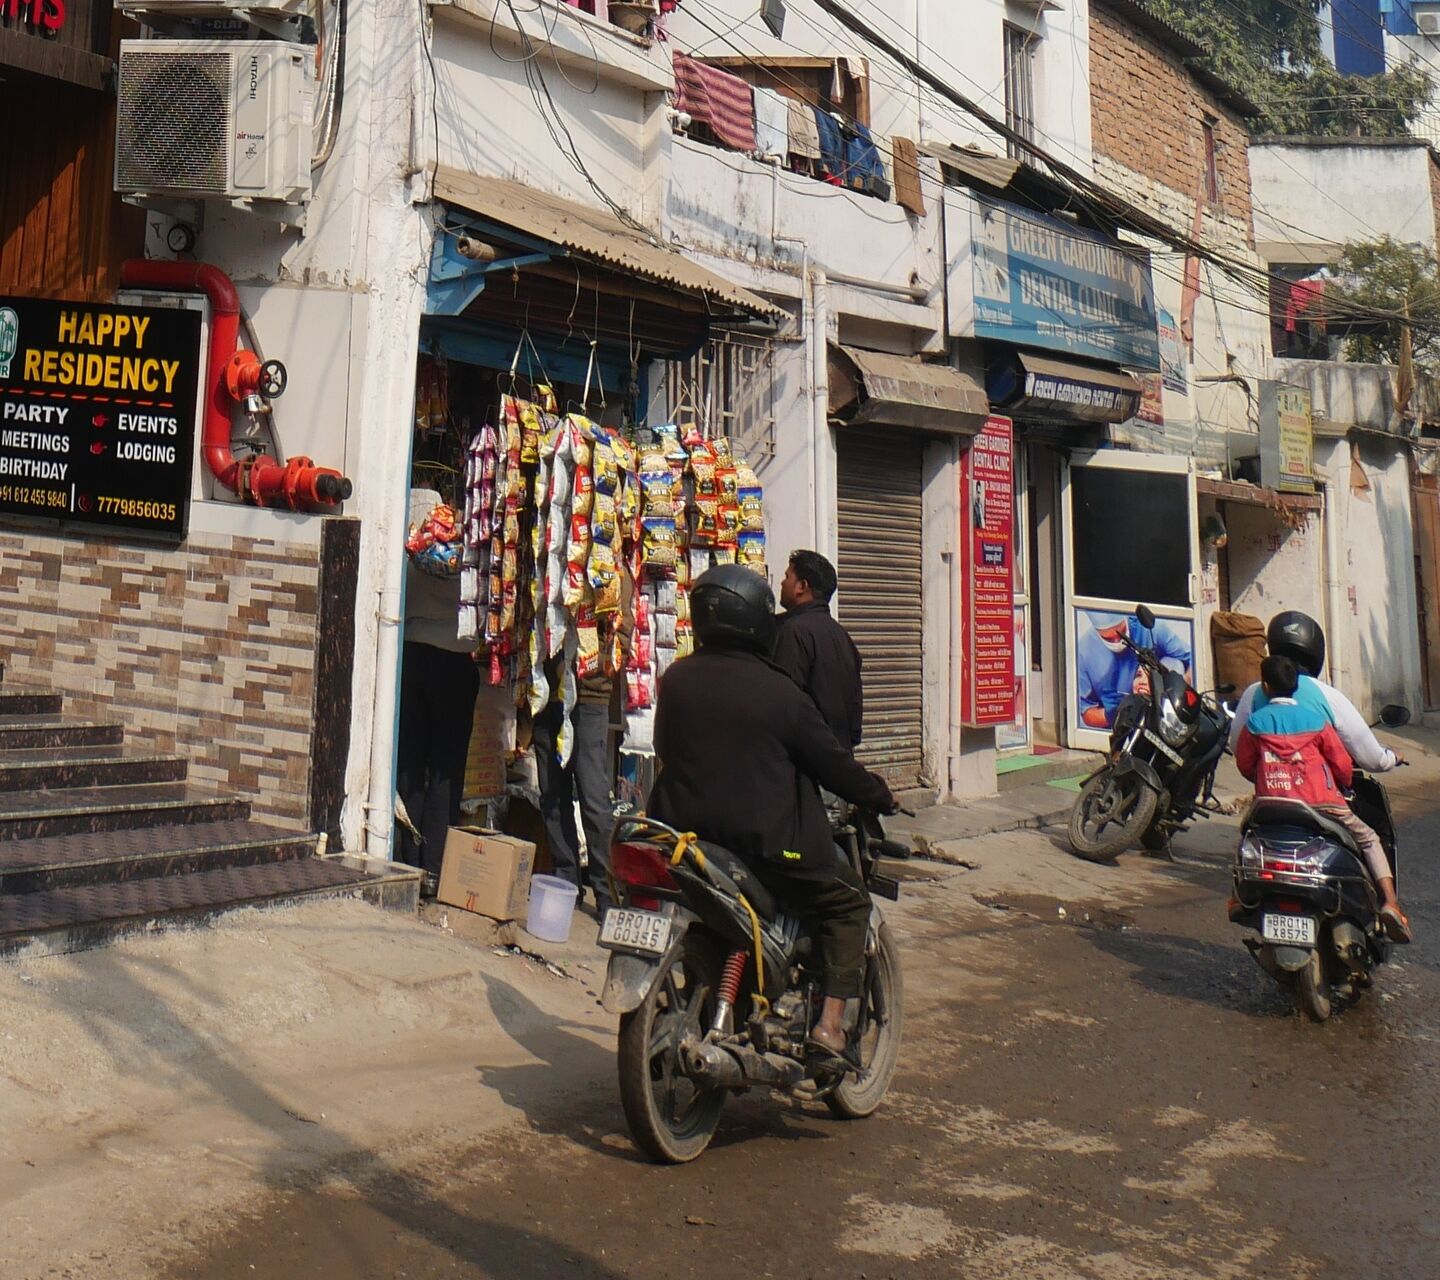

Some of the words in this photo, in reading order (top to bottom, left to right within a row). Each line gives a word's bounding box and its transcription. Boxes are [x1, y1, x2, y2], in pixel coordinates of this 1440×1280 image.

[249, 56, 258, 100] HITACHI
[236, 131, 247, 140] air
[1009, 216, 1057, 263] GREEN
[1020, 268, 1077, 315] DENTAL
[1077, 284, 1121, 326] CLINIC
[58, 310, 150, 350] HAPPY
[23, 349, 180, 394] RESIDENCY
[3, 402, 69, 425] PARTY
[117, 413, 178, 436] EVENTS
[1, 429, 71, 454] MEETINGS
[116, 441, 177, 464] LODGING
[974, 433, 988, 449] GREEN
[0, 456, 69, 481] BIRTHDAY
[974, 451, 994, 468] DENTAL
[994, 453, 1010, 471] CLINIC
[14, 486, 29, 503] 612
[30, 489, 46, 506] 455
[47, 491, 68, 509] 9840
[97, 496, 177, 521] 7779856035
[1266, 779, 1291, 791] King
[616, 911, 663, 933] BR01C
[1272, 915, 1309, 930] BR01H
[1273, 928, 1309, 941] X8575
